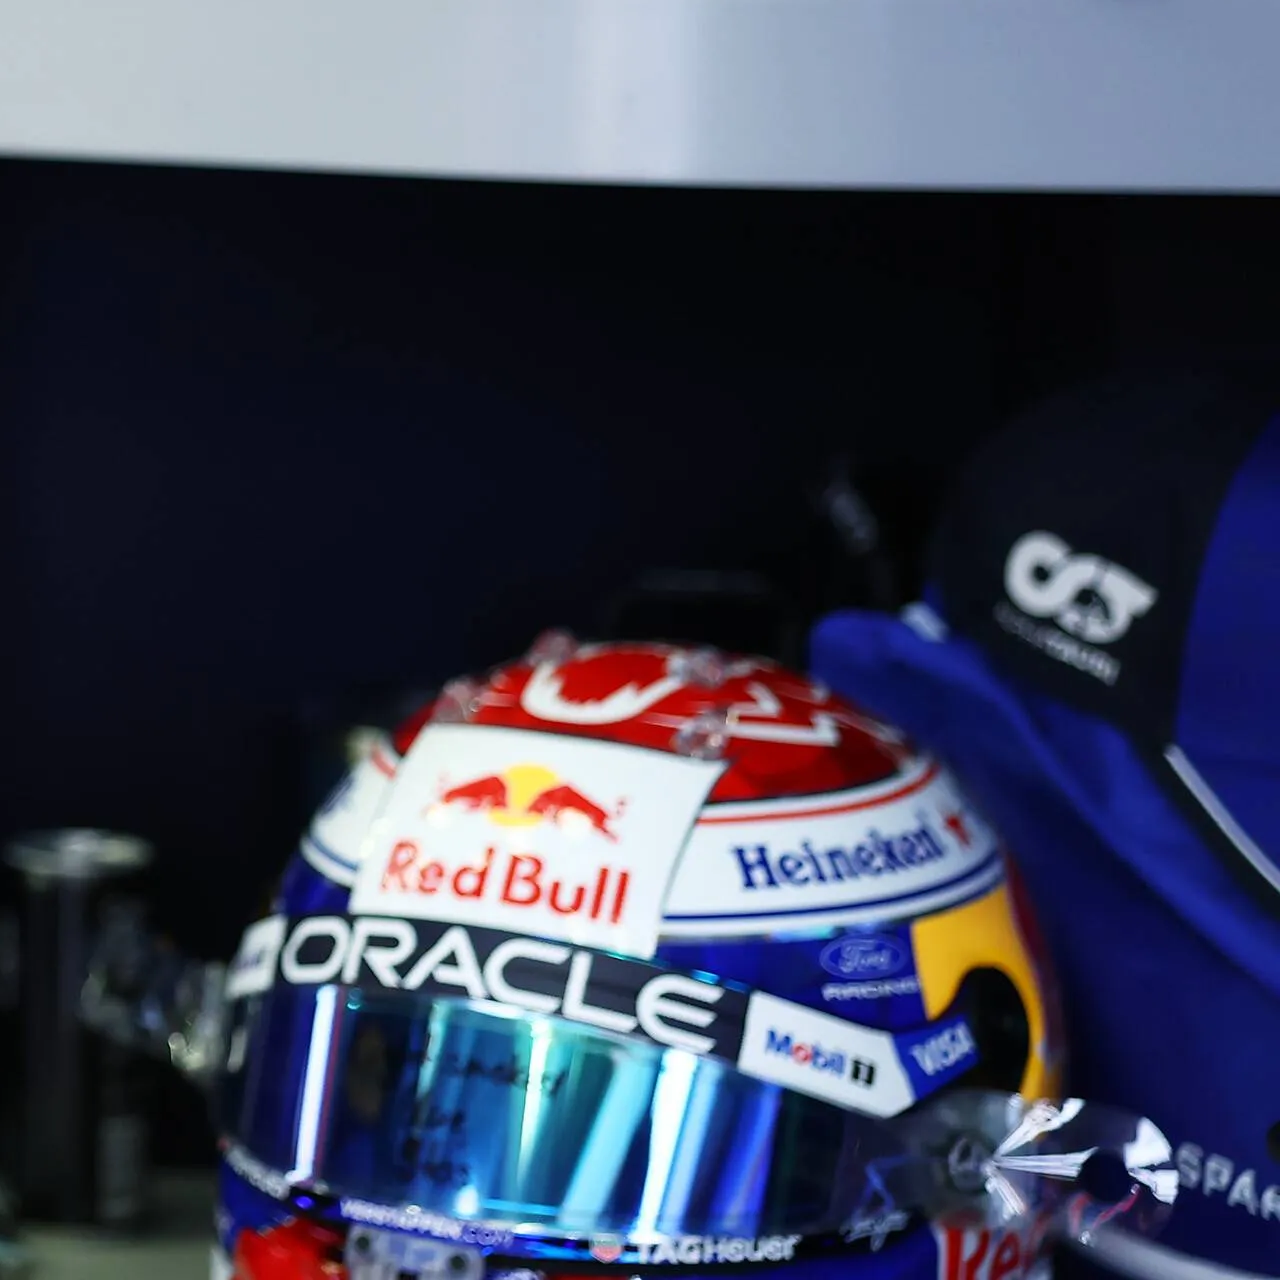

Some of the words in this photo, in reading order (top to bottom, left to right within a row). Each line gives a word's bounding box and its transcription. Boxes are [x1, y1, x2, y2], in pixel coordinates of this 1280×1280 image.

[380, 840, 495, 901] Red
[502, 853, 632, 926] Bull
[732, 815, 945, 891] Heineken
[280, 916, 726, 1053] ORACLE
[765, 1027, 847, 1077] Mobil
